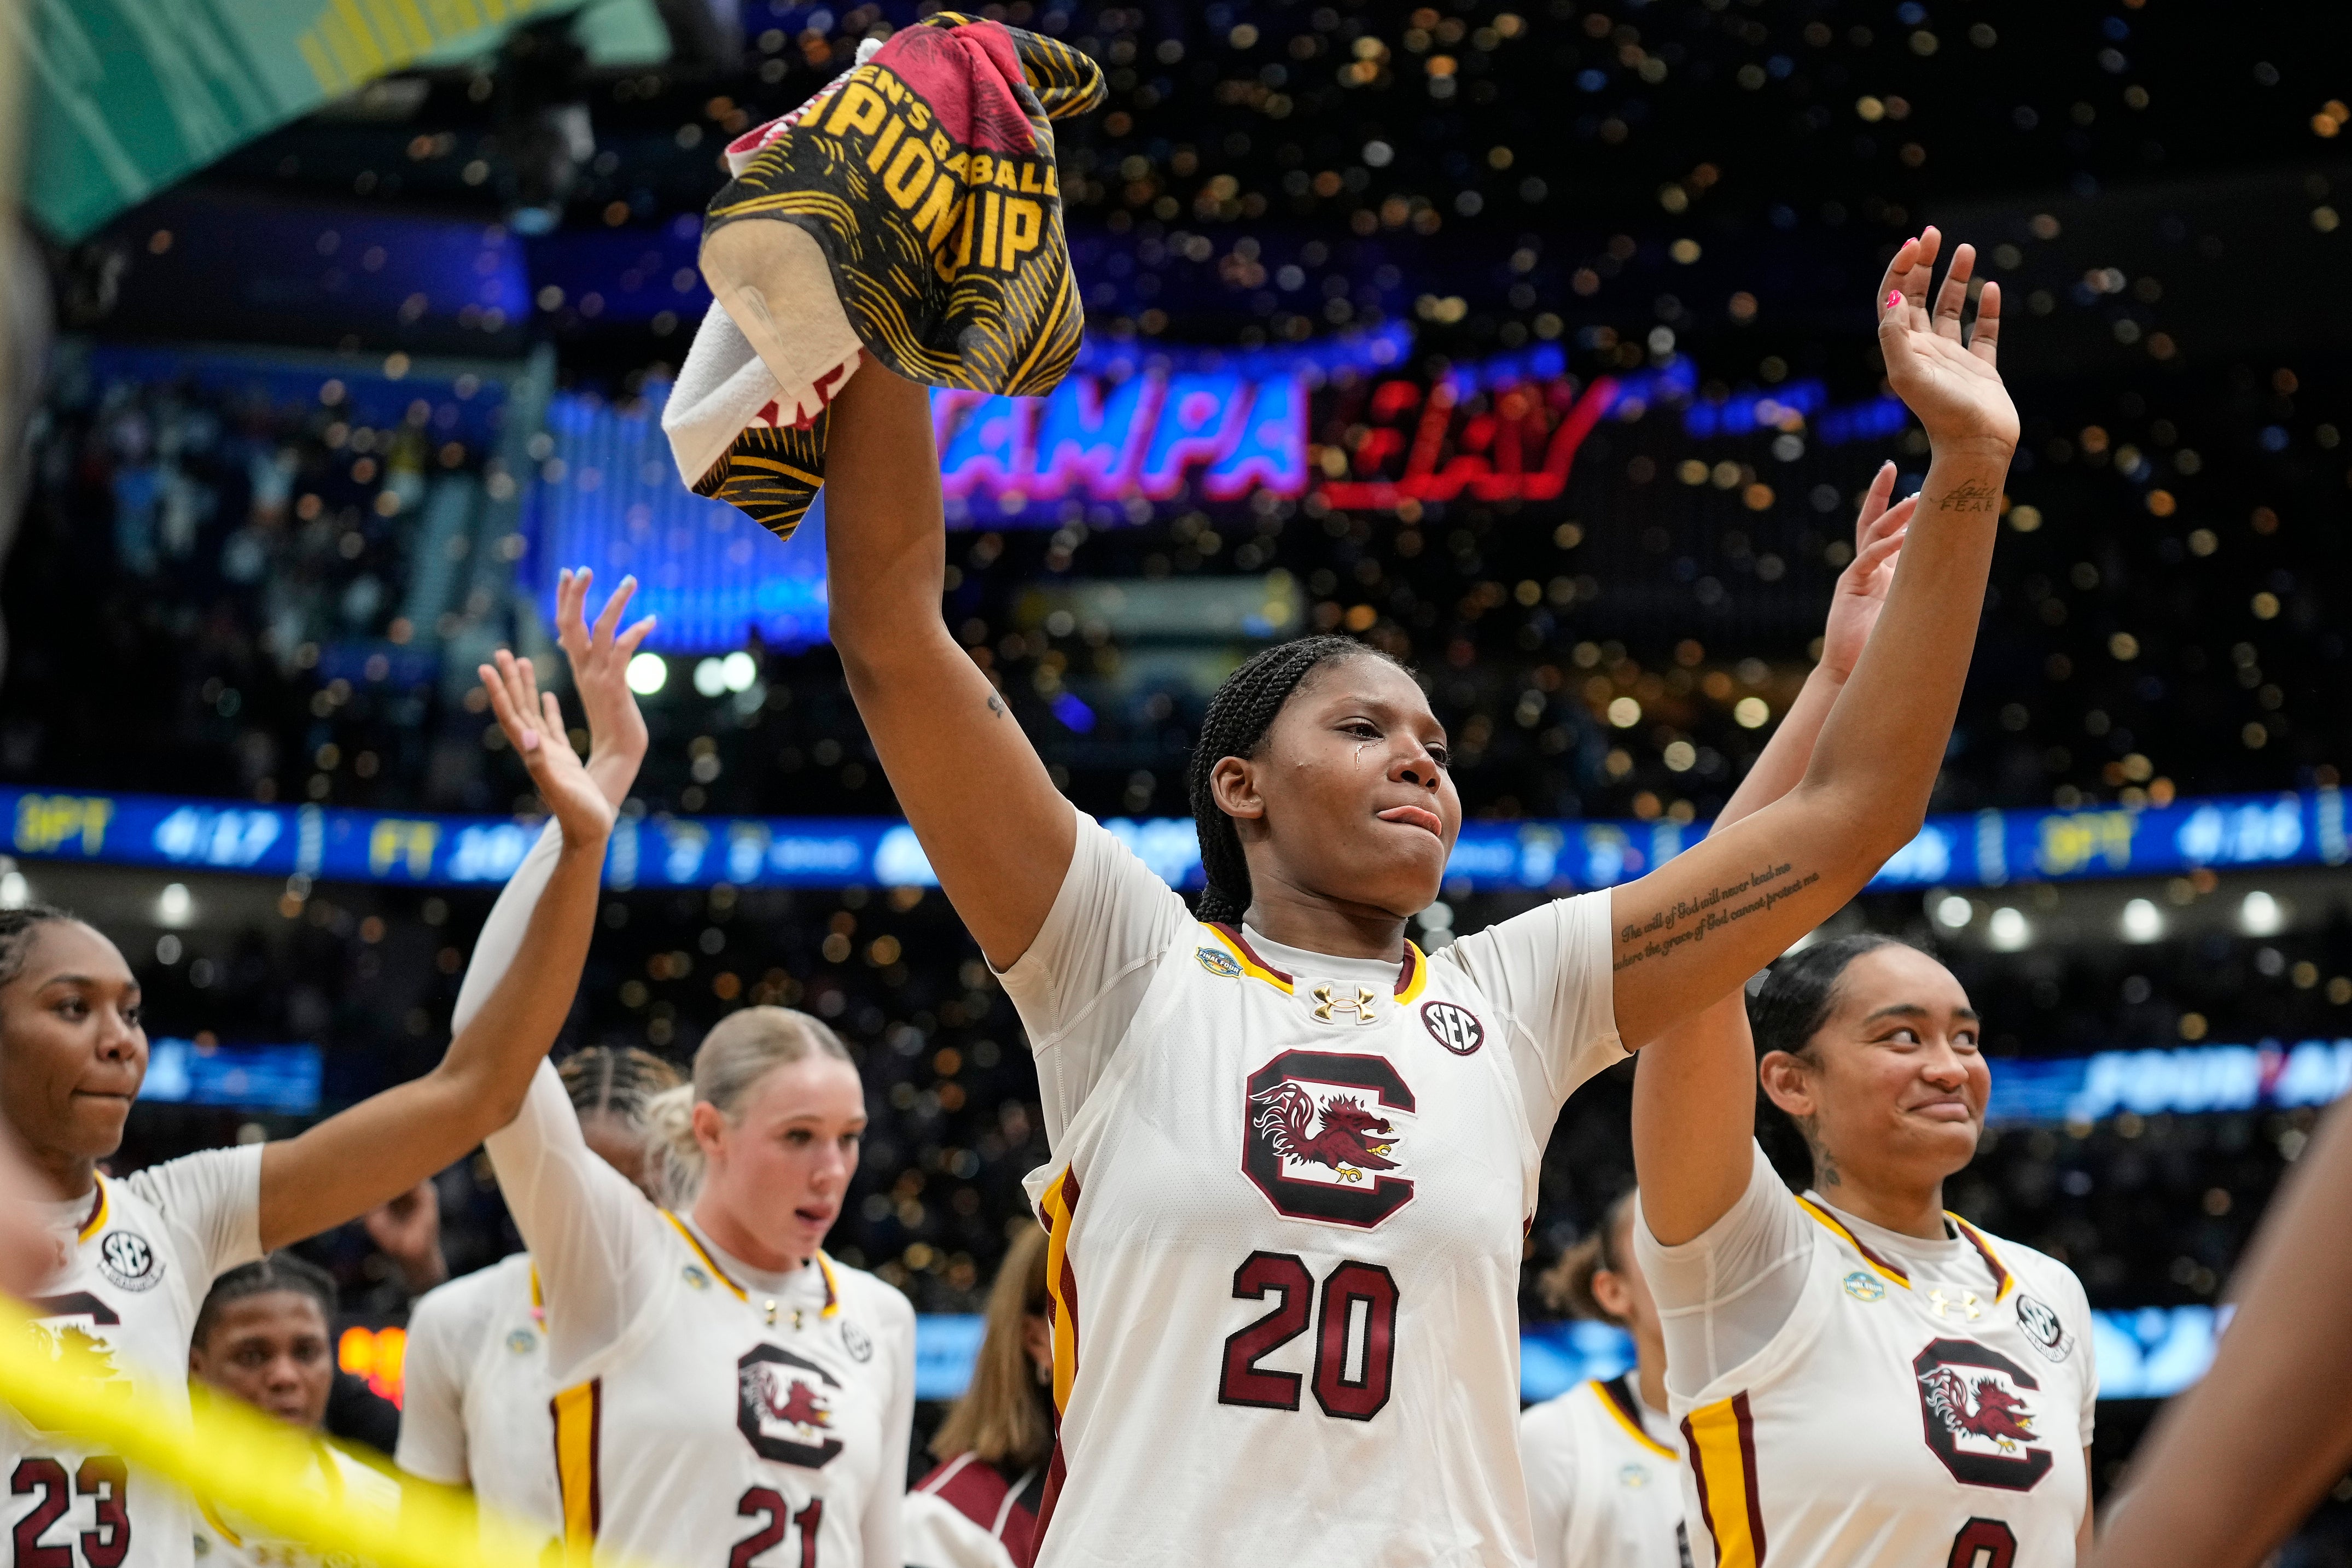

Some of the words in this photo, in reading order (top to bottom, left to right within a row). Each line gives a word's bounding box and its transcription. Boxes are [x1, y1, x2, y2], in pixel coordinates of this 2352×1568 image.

[1940, 499, 1995, 512] FEAR
[1621, 924, 1642, 942] The
[1644, 912, 1663, 932] will
[1666, 906, 1676, 929] of
[1678, 896, 1699, 919] God
[1701, 888, 1720, 909] will
[1722, 881, 1749, 900] never
[1751, 865, 1774, 887] lead
[1775, 863, 1792, 876] me
[1645, 941, 1661, 957] the
[1661, 931, 1693, 956] grace
[1695, 918, 1706, 941] of
[1707, 907, 1729, 930] God
[1731, 897, 1766, 920] cannot
[1766, 879, 1802, 911] protect
[1803, 872, 1819, 886] me
[1199, 951, 1219, 964] FINAL
[1220, 960, 1239, 973] FOUR
[1425, 1003, 1479, 1051] SEC
[104, 1233, 150, 1276] SEC
[1218, 1250, 1400, 1422] 20
[2019, 1295, 2059, 1345] SEC
[11, 1456, 131, 1568] 23
[728, 1483, 823, 1568] 21
